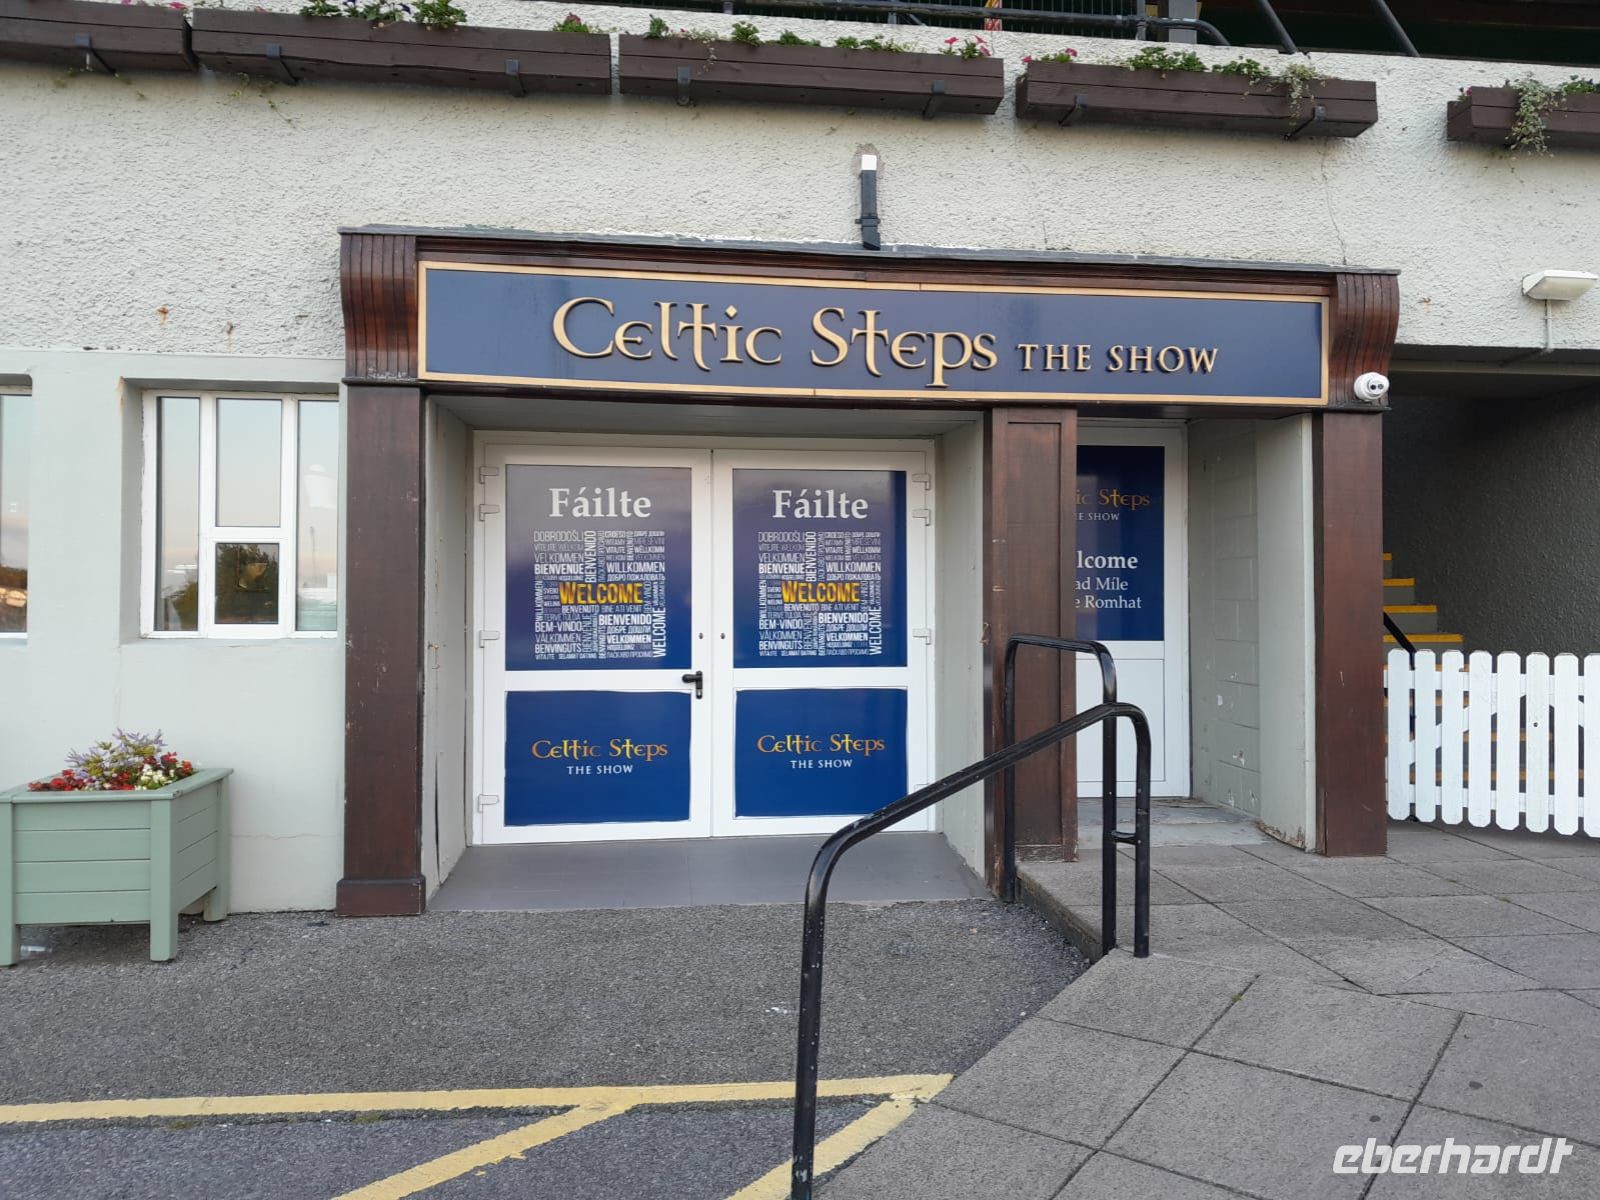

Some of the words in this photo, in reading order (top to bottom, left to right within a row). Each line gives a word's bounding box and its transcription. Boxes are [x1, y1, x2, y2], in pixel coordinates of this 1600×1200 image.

[553, 296, 783, 373] Celtic
[810, 306, 998, 388] Steps
[1016, 343, 1092, 372] THE
[1105, 345, 1218, 374] SHOW
[548, 486, 652, 518] Fáilte
[772, 488, 868, 519] Fáilte
[1098, 488, 1151, 510] Steps
[1088, 512, 1120, 521] SHOW
[534, 552, 584, 563] VELKOMMEN
[584, 530, 597, 583] BIENVENIDO
[759, 552, 805, 563] VELKOMMEN
[804, 531, 817, 582] BIENVENIDO
[1076, 550, 1139, 569] lcome
[534, 563, 584, 575] BIENVENUE
[606, 561, 665, 573] WILLKOMMEN
[759, 563, 805, 574] BIENVENUE
[825, 561, 881, 573] WILLKOMMEN
[1074, 577, 1091, 591] ad
[1096, 577, 1129, 591] Míle
[558, 581, 645, 605] WELCOME
[782, 580, 861, 603] WELCOME
[535, 580, 543, 622] WILLKOMMEN
[1083, 595, 1143, 609] Romhat
[598, 613, 652, 626] BIENVENIDO
[758, 619, 804, 630] BEM-VINDO
[818, 612, 869, 624] BIENVENIDO
[535, 621, 582, 632] BEM-VINDO
[582, 613, 593, 652] BIENVENUE
[651, 607, 667, 659] WELCOME
[868, 606, 882, 656] WELCOME
[607, 634, 652, 644] VELKOMMEN
[826, 632, 869, 642] VELKOMMEN
[535, 643, 582, 654] BENVINGUTS
[758, 640, 803, 651] BENVINGUTS
[532, 739, 601, 761] Celtic
[609, 738, 668, 762] Steps
[757, 734, 822, 755] Celtic
[829, 733, 886, 757] Steps
[566, 765, 592, 775] THE
[596, 764, 633, 775] SHOW
[790, 760, 814, 769] THE
[817, 759, 853, 769] SHOW
